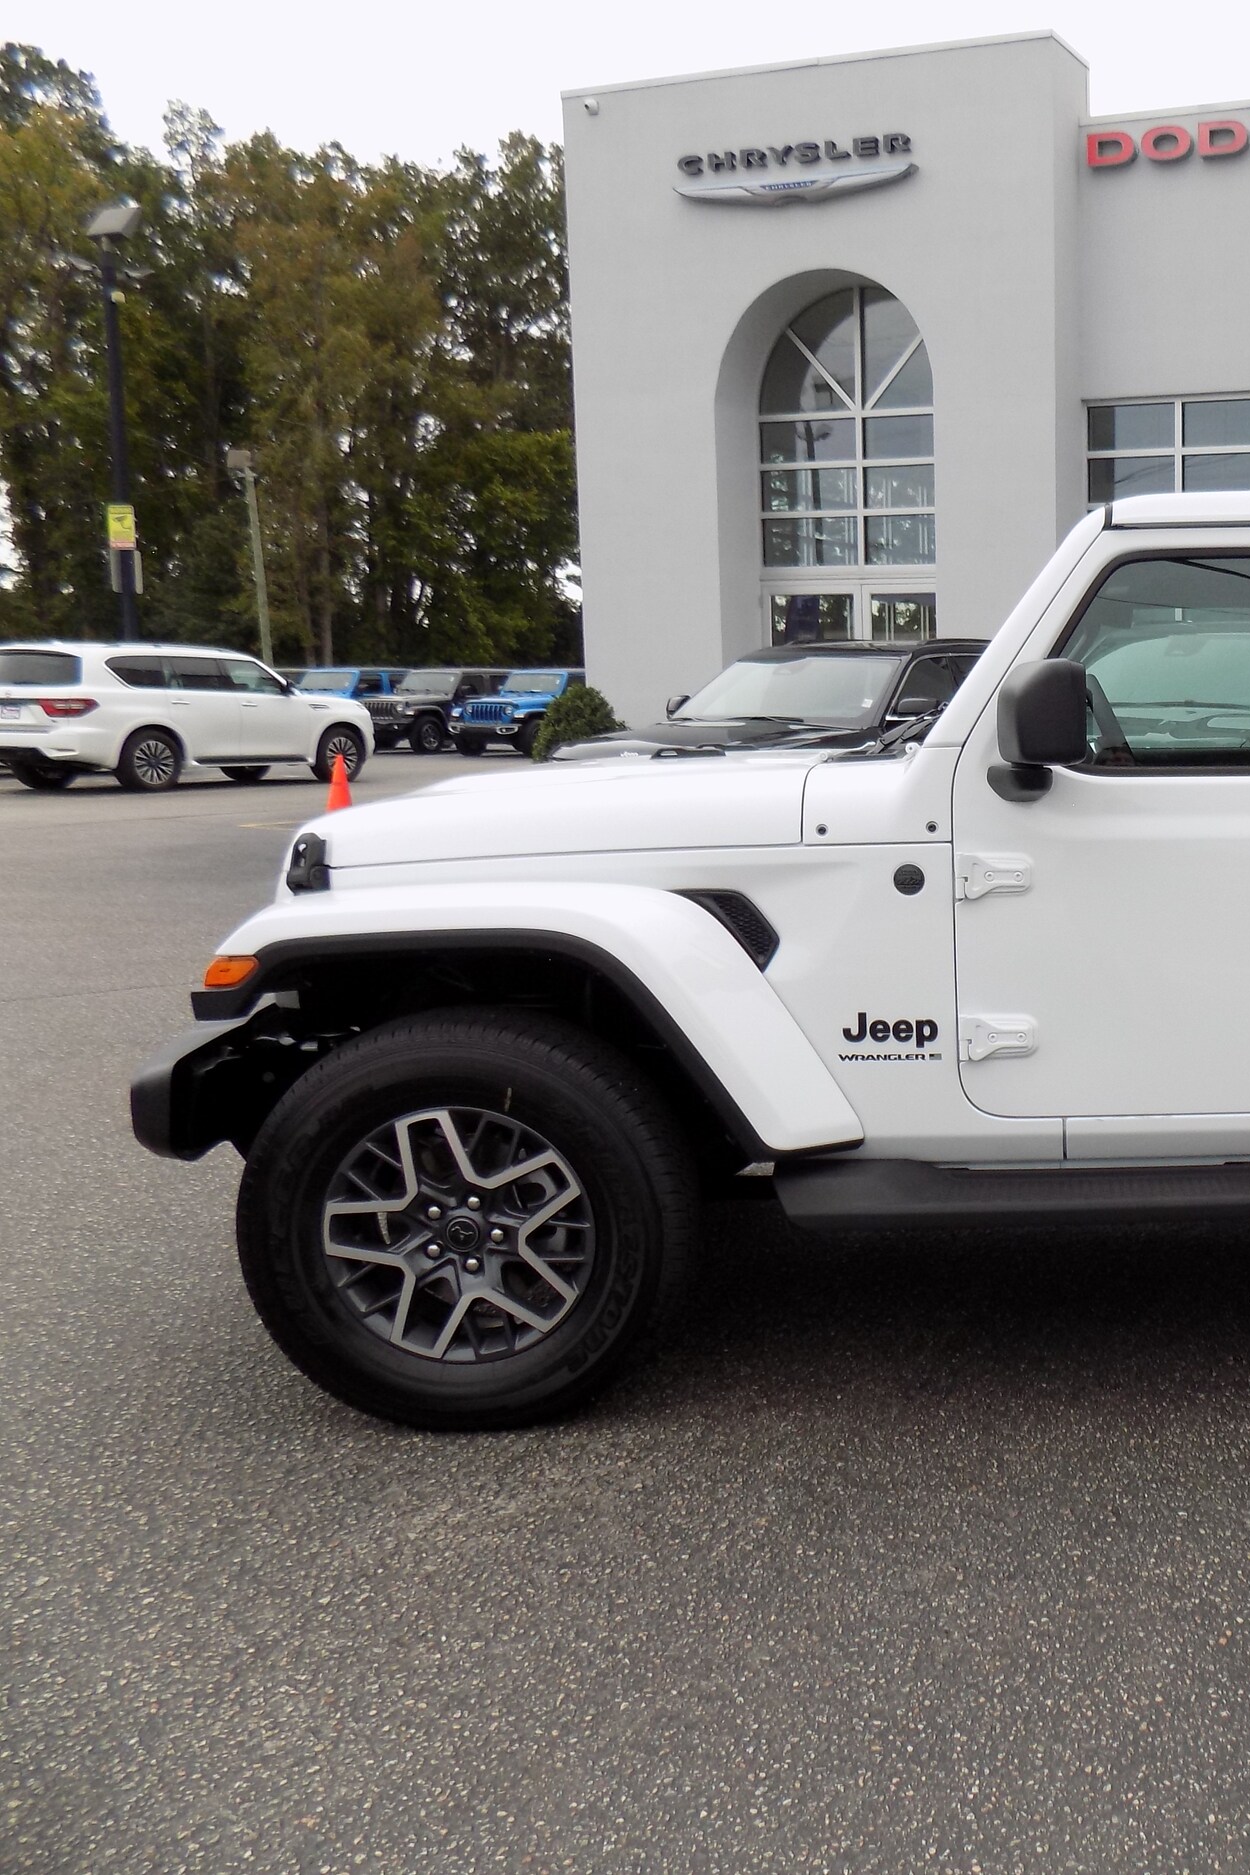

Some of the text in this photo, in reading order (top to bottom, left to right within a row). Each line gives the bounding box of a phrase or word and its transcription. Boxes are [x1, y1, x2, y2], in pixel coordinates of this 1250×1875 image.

[677, 133, 911, 176] CHRYSLER
[842, 1012, 938, 1048] Jeep
[838, 1053, 926, 1062] WRANGLER
